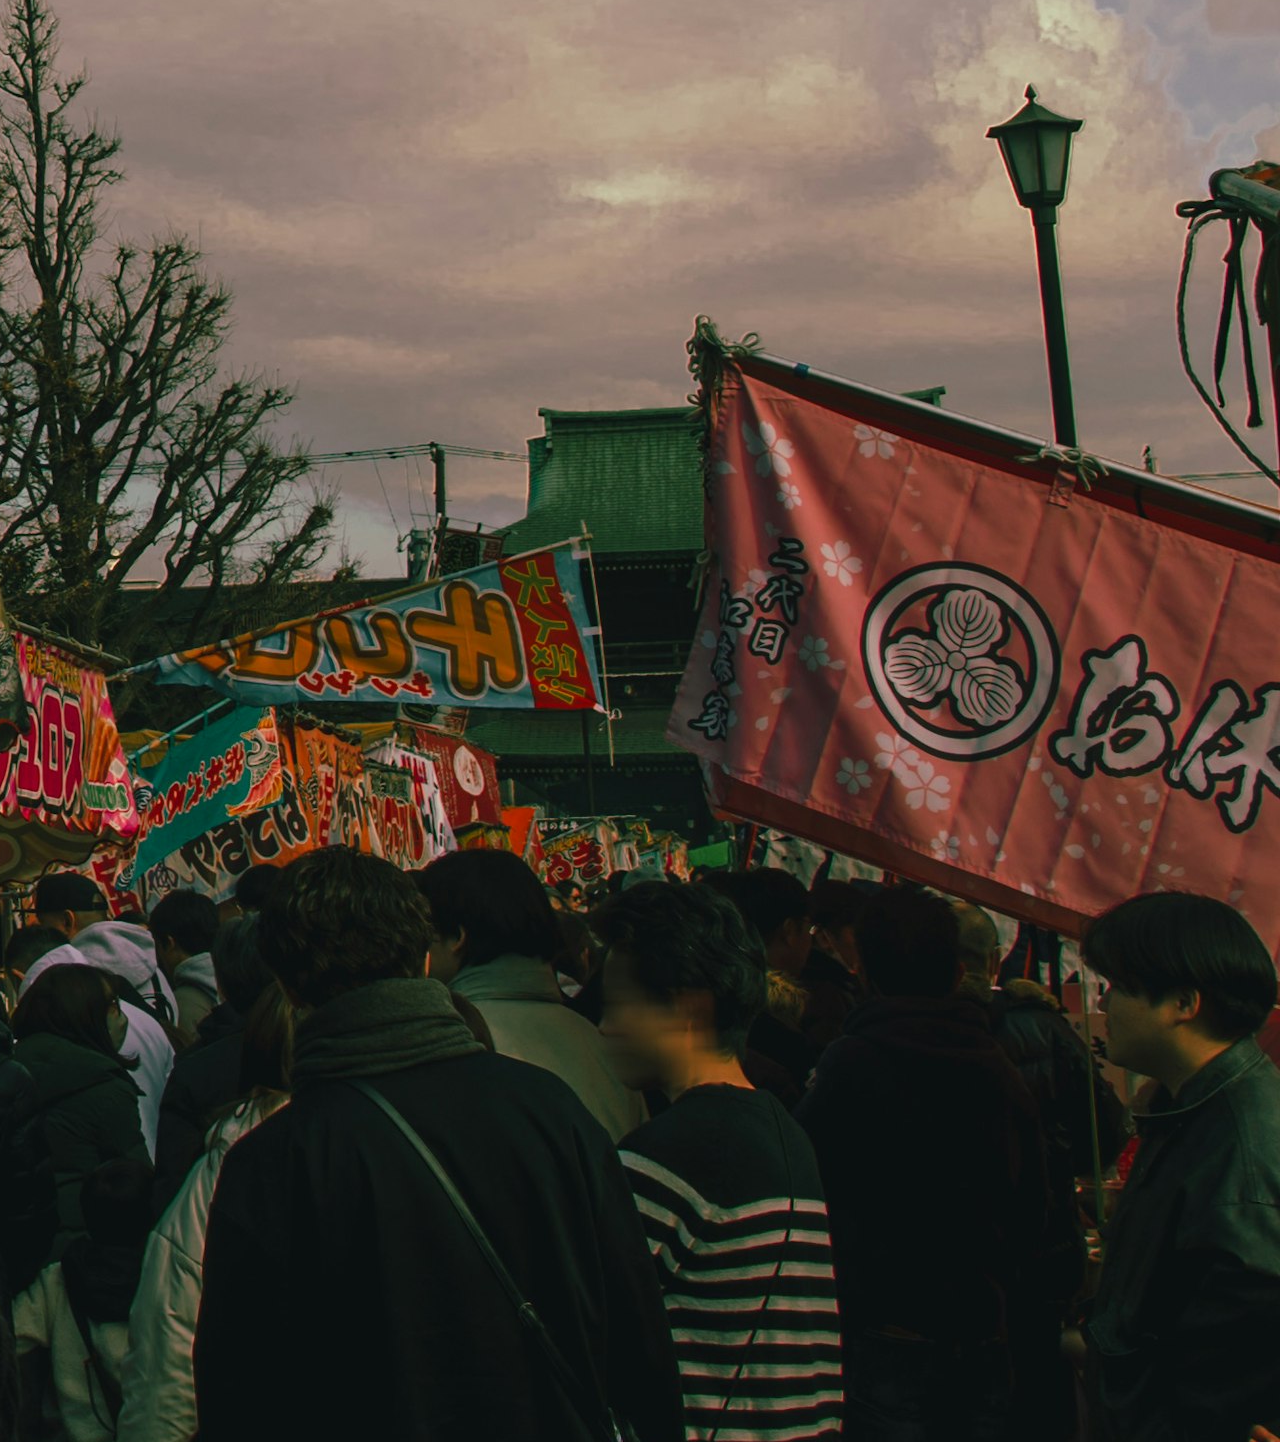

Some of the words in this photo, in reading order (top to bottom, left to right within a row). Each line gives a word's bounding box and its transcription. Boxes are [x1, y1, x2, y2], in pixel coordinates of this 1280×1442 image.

[502, 560, 586, 704] 大人気!!
[749, 537, 809, 665] 二代目
